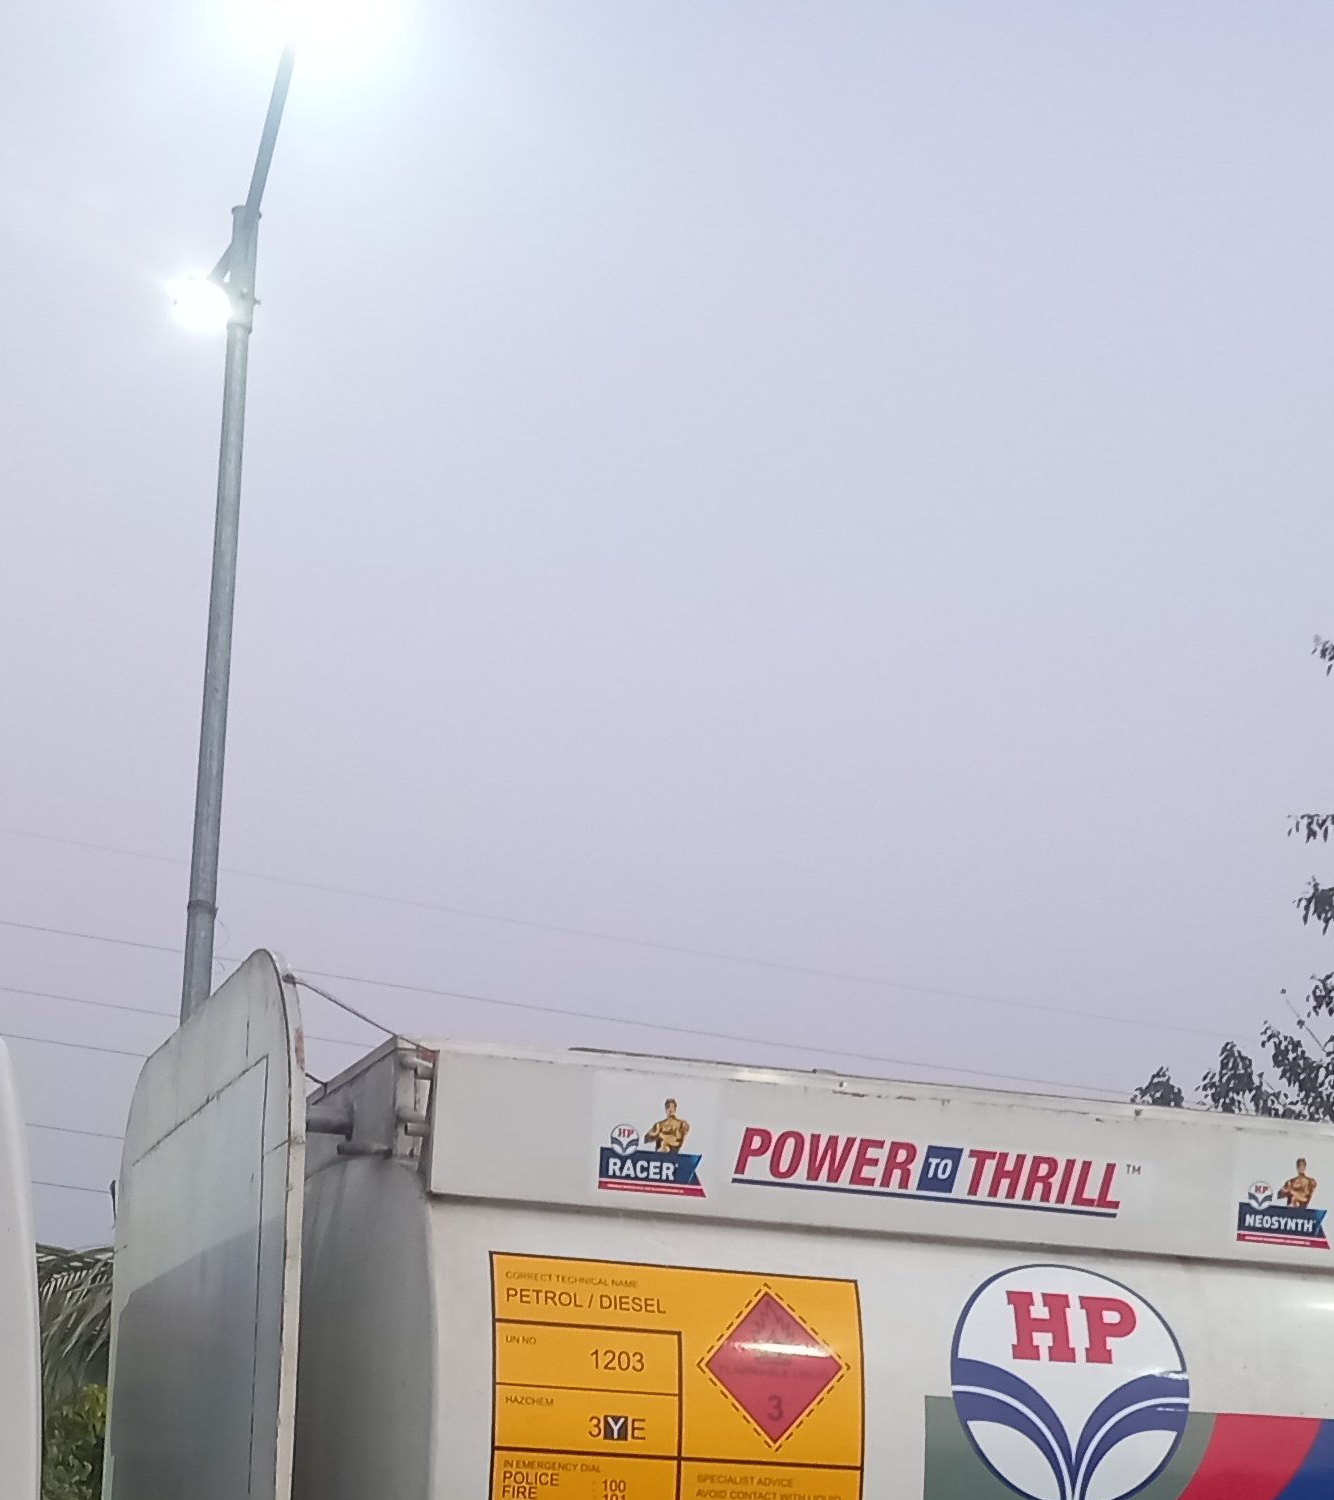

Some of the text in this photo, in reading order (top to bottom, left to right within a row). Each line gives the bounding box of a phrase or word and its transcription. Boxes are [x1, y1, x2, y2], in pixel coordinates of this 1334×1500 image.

[607, 1157, 676, 1181] RACER
[733, 1126, 917, 1190] POWER
[927, 1157, 952, 1180] TO
[967, 1149, 1120, 1209] THRILL
[1244, 1213, 1314, 1233] NEOSYNTH
[505, 1270, 639, 1288] CORRECT TECHNICAL NAME
[505, 1286, 583, 1309] PETROL
[599, 1294, 667, 1314] DIESEL
[1005, 1289, 1137, 1364] HP
[505, 1335, 520, 1344] UN
[590, 1348, 645, 1373] 1203
[505, 1395, 554, 1407] HAZCHEM
[767, 1394, 784, 1421] 3
[588, 1415, 647, 1441] 3YE
[517, 1460, 578, 1472] EMERGENCY
[580, 1463, 601, 1473] DIAL
[502, 1470, 627, 1494] POLICE 100
[696, 1473, 794, 1488] SPECIALIST ADVICE
[501, 1484, 538, 1500] FIRE
[695, 1488, 727, 1499] AVOID
[729, 1490, 777, 1500] CONTACT
